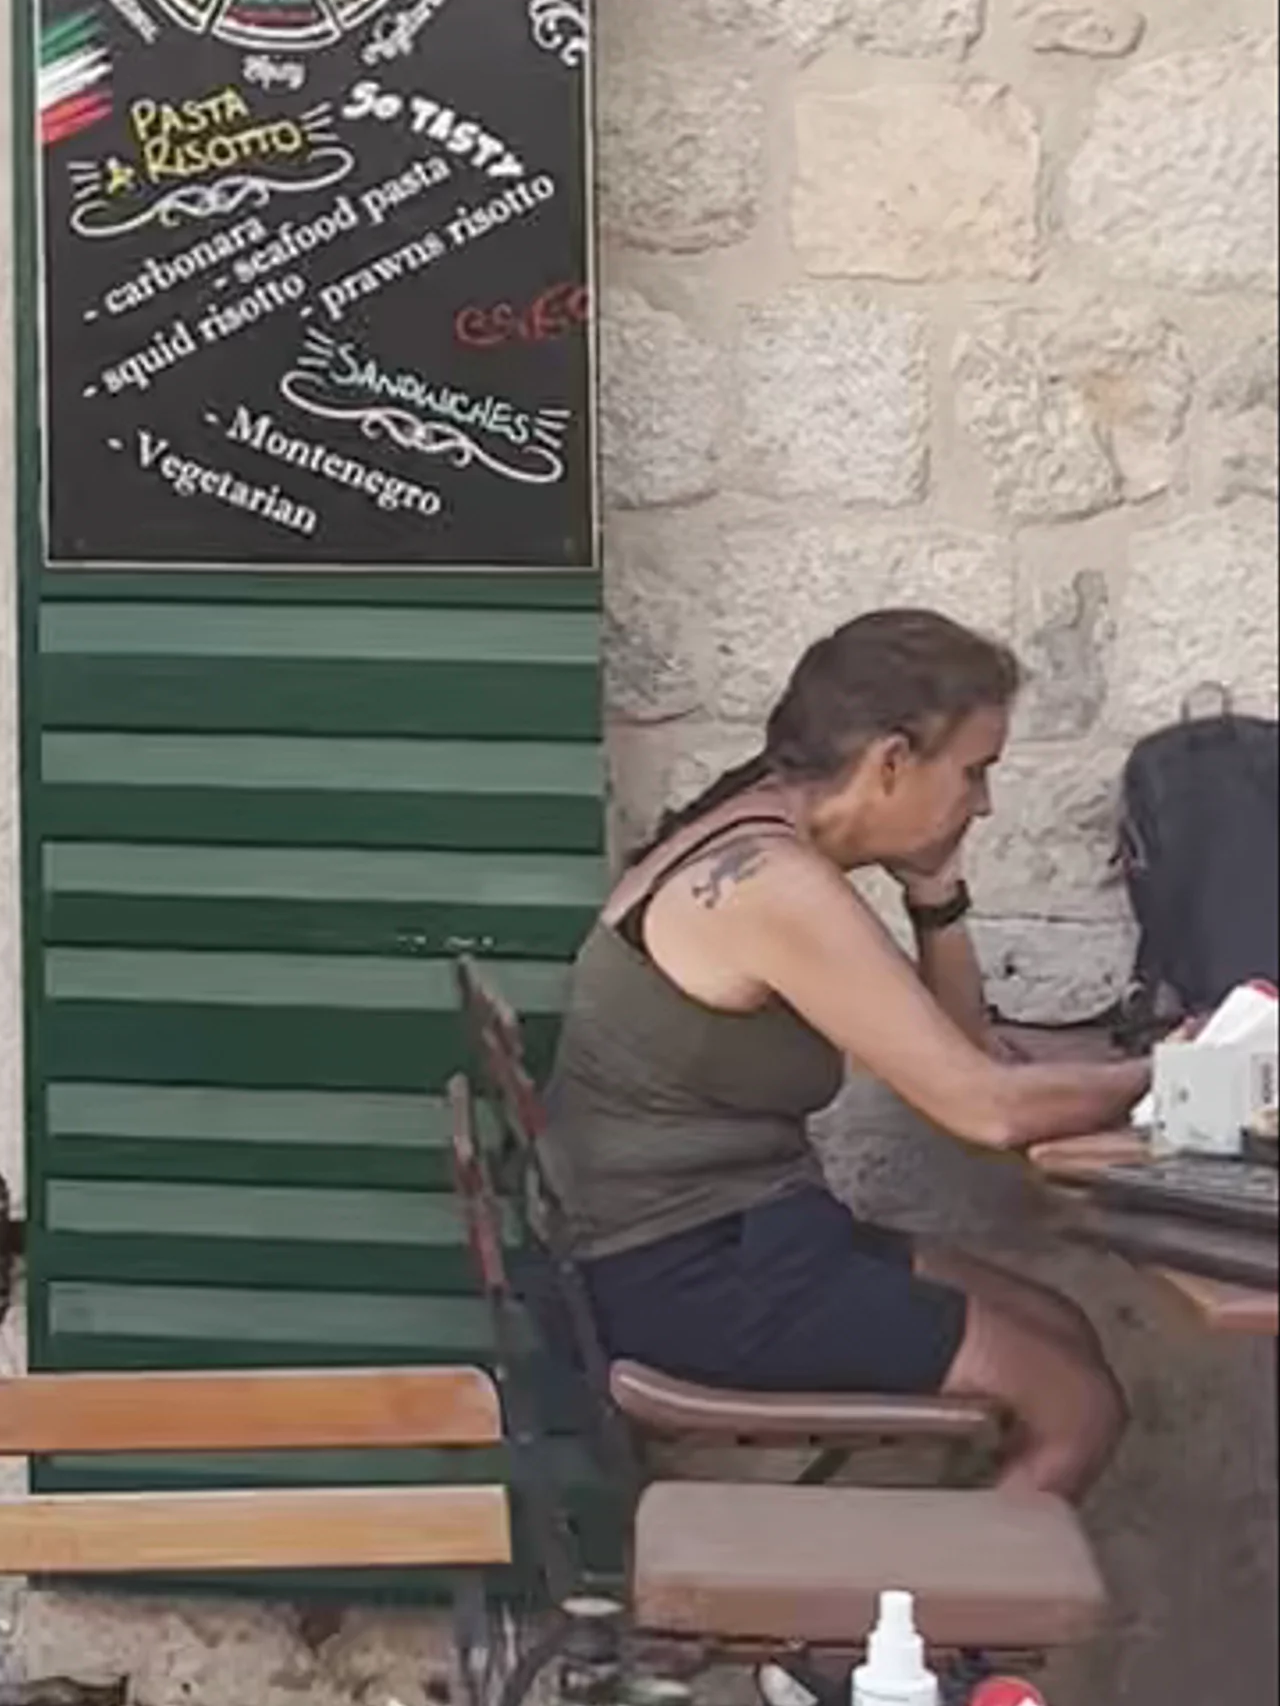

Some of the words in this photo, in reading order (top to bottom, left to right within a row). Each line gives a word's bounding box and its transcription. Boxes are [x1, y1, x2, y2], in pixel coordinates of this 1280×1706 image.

[130, 87, 249, 140] PASTA
[144, 121, 303, 183] RISOTTO
[409, 96, 525, 178] TASTY
[104, 215, 269, 315] carbonara
[233, 198, 359, 281] seafood
[361, 154, 451, 223] pasta
[320, 229, 445, 320] prawns
[446, 175, 555, 245] risotto
[100, 321, 197, 398] squid
[199, 273, 307, 344] risotto
[330, 342, 533, 444] SANDWICHES
[138, 429, 318, 535] Vegetarian
[226, 406, 442, 516] Montenegro
